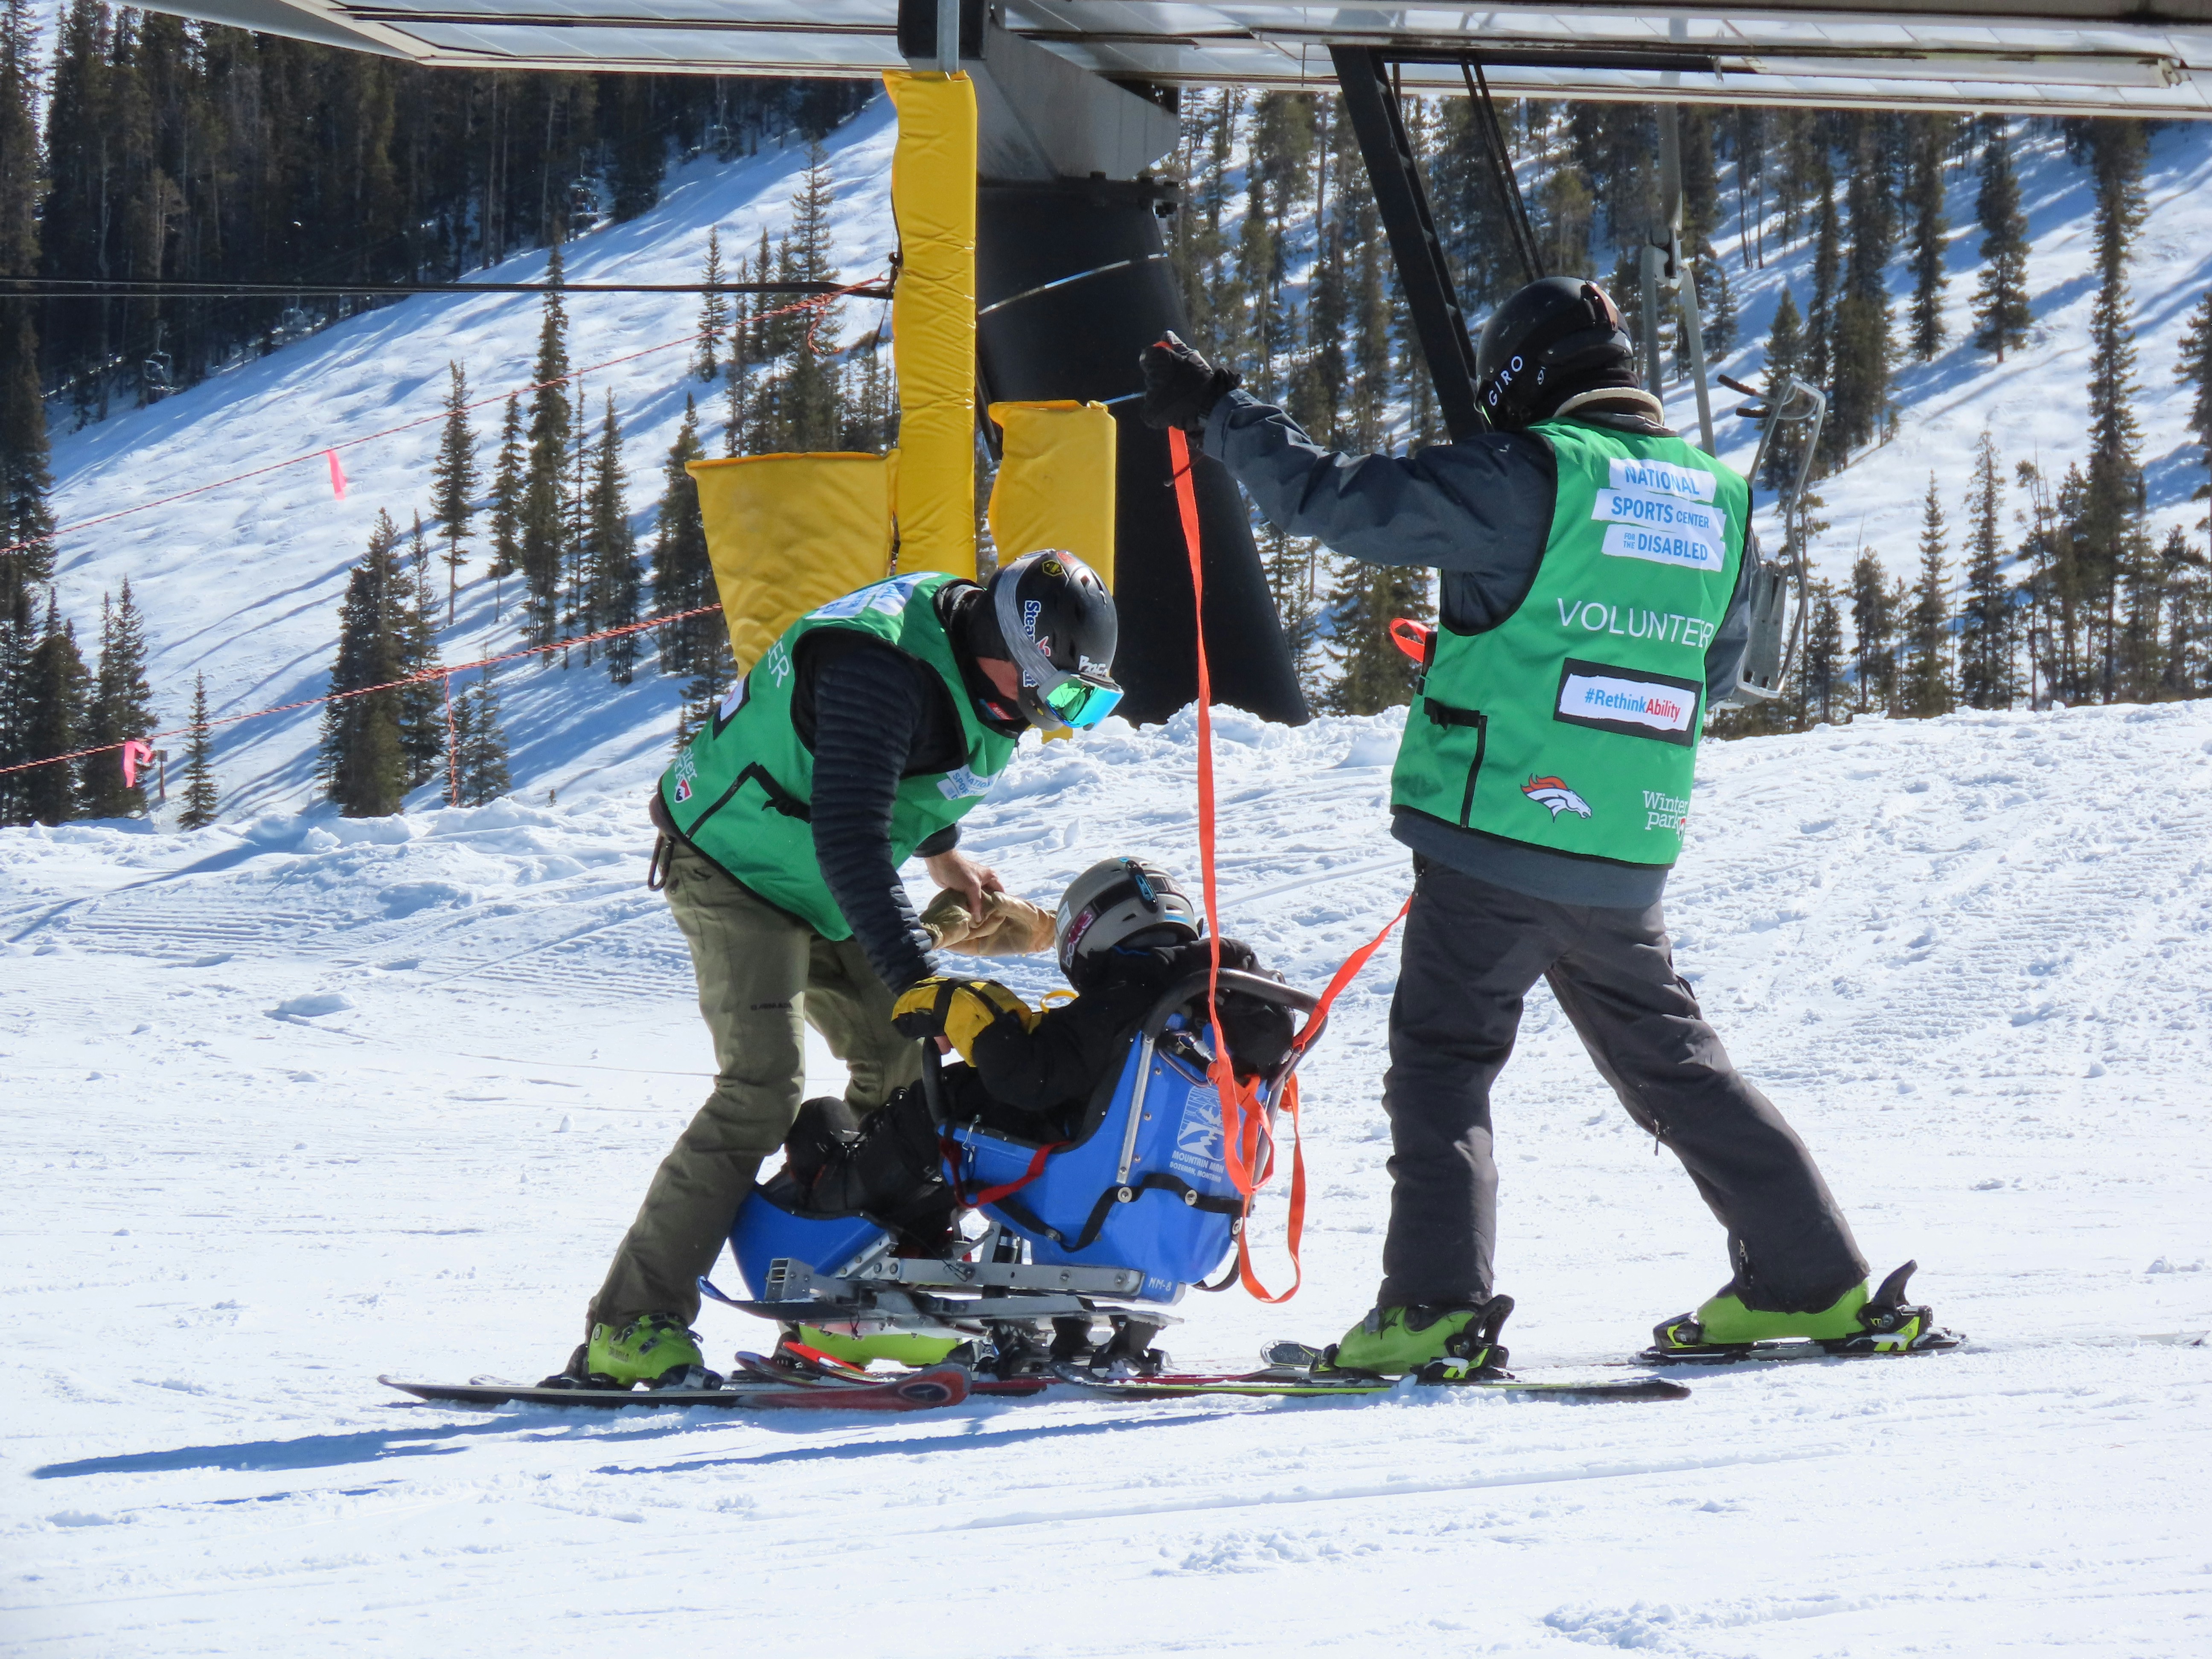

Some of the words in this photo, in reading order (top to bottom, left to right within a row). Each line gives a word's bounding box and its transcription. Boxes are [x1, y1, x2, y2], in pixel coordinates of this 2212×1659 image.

[1489, 356, 1523, 406] GIRO
[1625, 466, 1700, 495] NATIONAL
[1611, 496, 1674, 524] SPORTS
[1676, 510, 1709, 529] CENTER
[1624, 533, 1635, 541] FOR
[1624, 541, 1635, 549] THE
[1638, 533, 1707, 560] DISABLED
[1584, 687, 1681, 723] #RethinkAbility
[1642, 790, 1688, 814] Winter
[1172, 1150, 1208, 1168] MOUNTAIN
[1209, 1162, 1224, 1173] MAN
